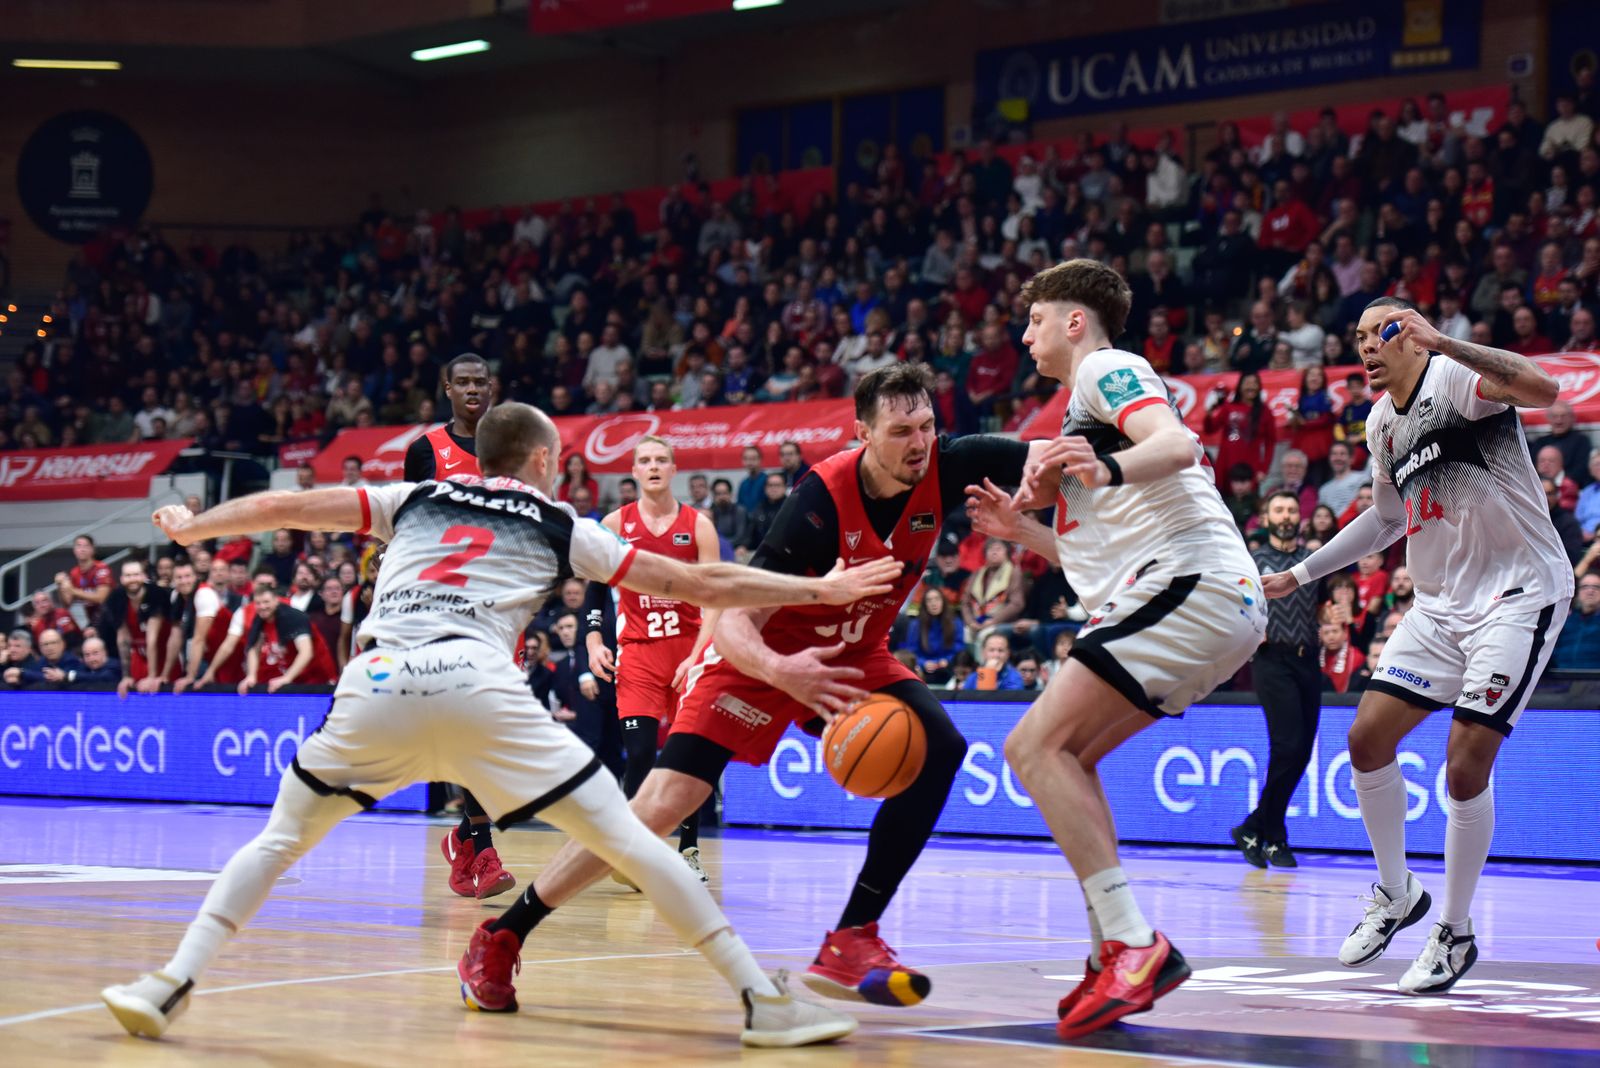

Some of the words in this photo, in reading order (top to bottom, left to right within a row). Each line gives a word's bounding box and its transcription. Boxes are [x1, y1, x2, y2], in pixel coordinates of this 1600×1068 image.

[1204, 17, 1377, 62] UNIVERSIDAD
[1047, 41, 1198, 105] UCAM
[418, 524, 495, 588] 2
[646, 610, 681, 638] 22
[1, 711, 165, 774] endesa
[212, 715, 305, 777] end
